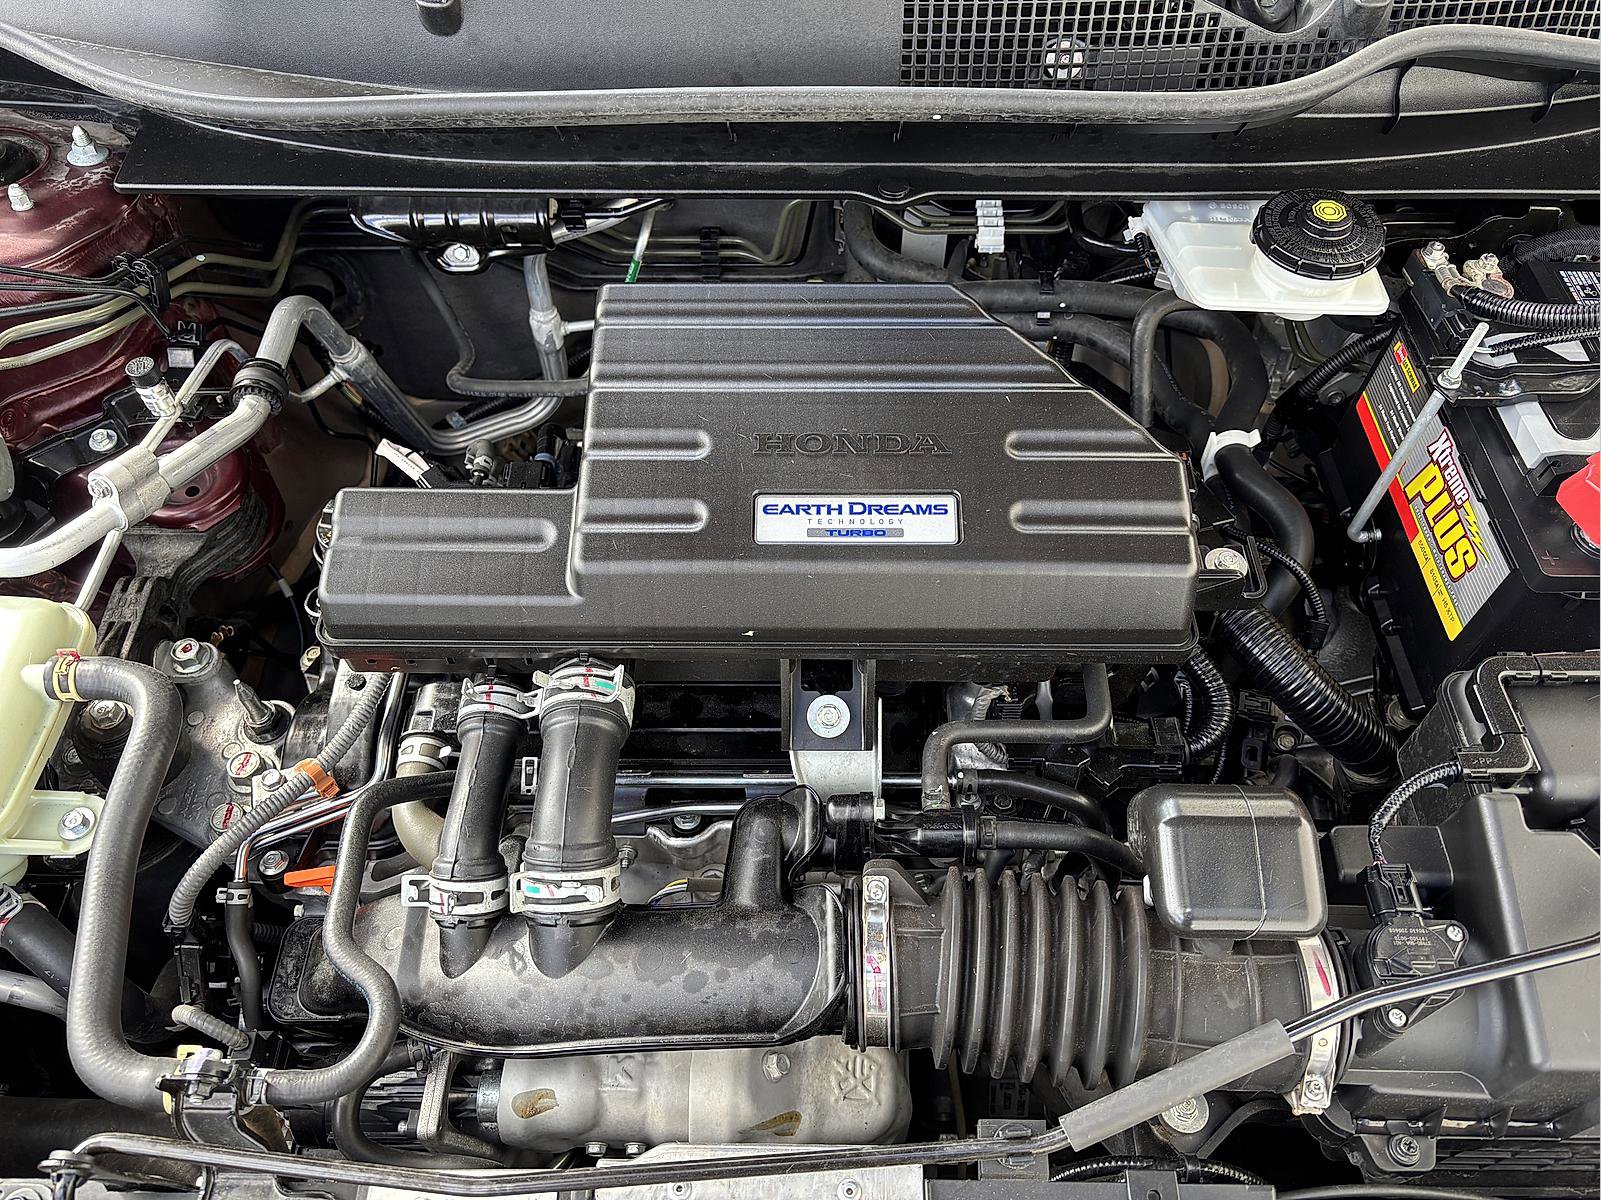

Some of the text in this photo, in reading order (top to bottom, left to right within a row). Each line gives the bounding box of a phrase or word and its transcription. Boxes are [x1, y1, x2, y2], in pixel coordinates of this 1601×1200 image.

[753, 432, 953, 455] HONDA
[1428, 429, 1470, 506] Xtreme
[762, 501, 949, 516] EARTH DREAMS
[807, 518, 904, 526] TECHNOLOGY
[1404, 463, 1478, 580] PLUS
[825, 529, 887, 537] TURBO
